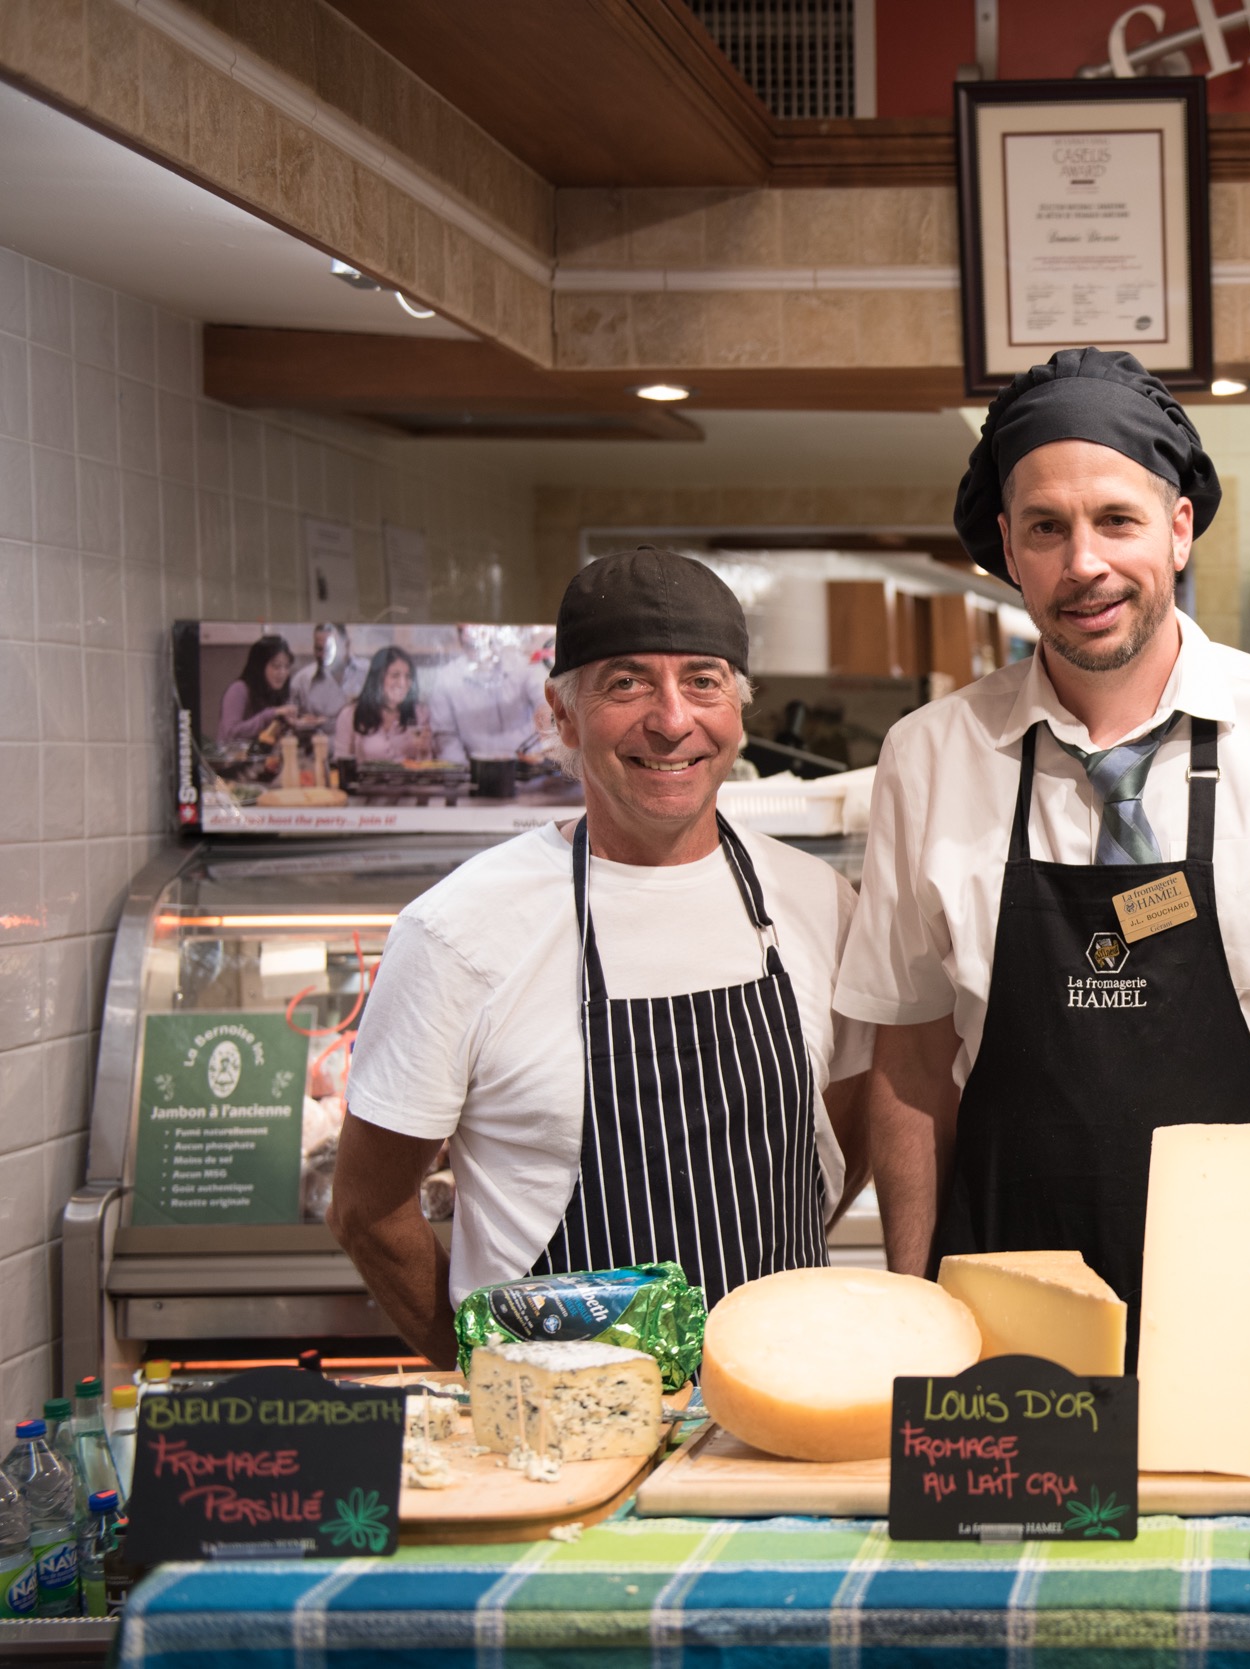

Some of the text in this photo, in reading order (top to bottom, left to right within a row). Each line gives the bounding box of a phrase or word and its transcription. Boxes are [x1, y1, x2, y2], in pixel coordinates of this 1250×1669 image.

[178, 709, 198, 804] SWISSMAR
[1122, 877, 1178, 903] La fromagerie
[1137, 886, 1182, 910] HAMEL
[1130, 901, 1190, 927] J.L. BOUCHARD
[1149, 920, 1173, 933] Gérant
[1067, 975, 1148, 990] La fromagerie
[1067, 989, 1148, 1009] HAMEL
[183, 1048, 198, 1067] La
[194, 1023, 256, 1048] Bernoise
[150, 1103, 292, 1120] Jambon à l'ancienne
[175, 1126, 268, 1137] Fumé naturellement
[174, 1141, 256, 1152] Aucun phosphate
[173, 1155, 233, 1165] Moins de sel
[172, 1169, 228, 1179] Aucun MSG
[197, 1183, 254, 1194] authentique
[171, 1197, 250, 1209] Recette originale
[899, 1419, 1020, 1467] FROMAGE
[148, 1433, 300, 1488] FROMAGE
[958, 1522, 972, 1535] La
[1025, 1521, 1064, 1535] HAMEL
